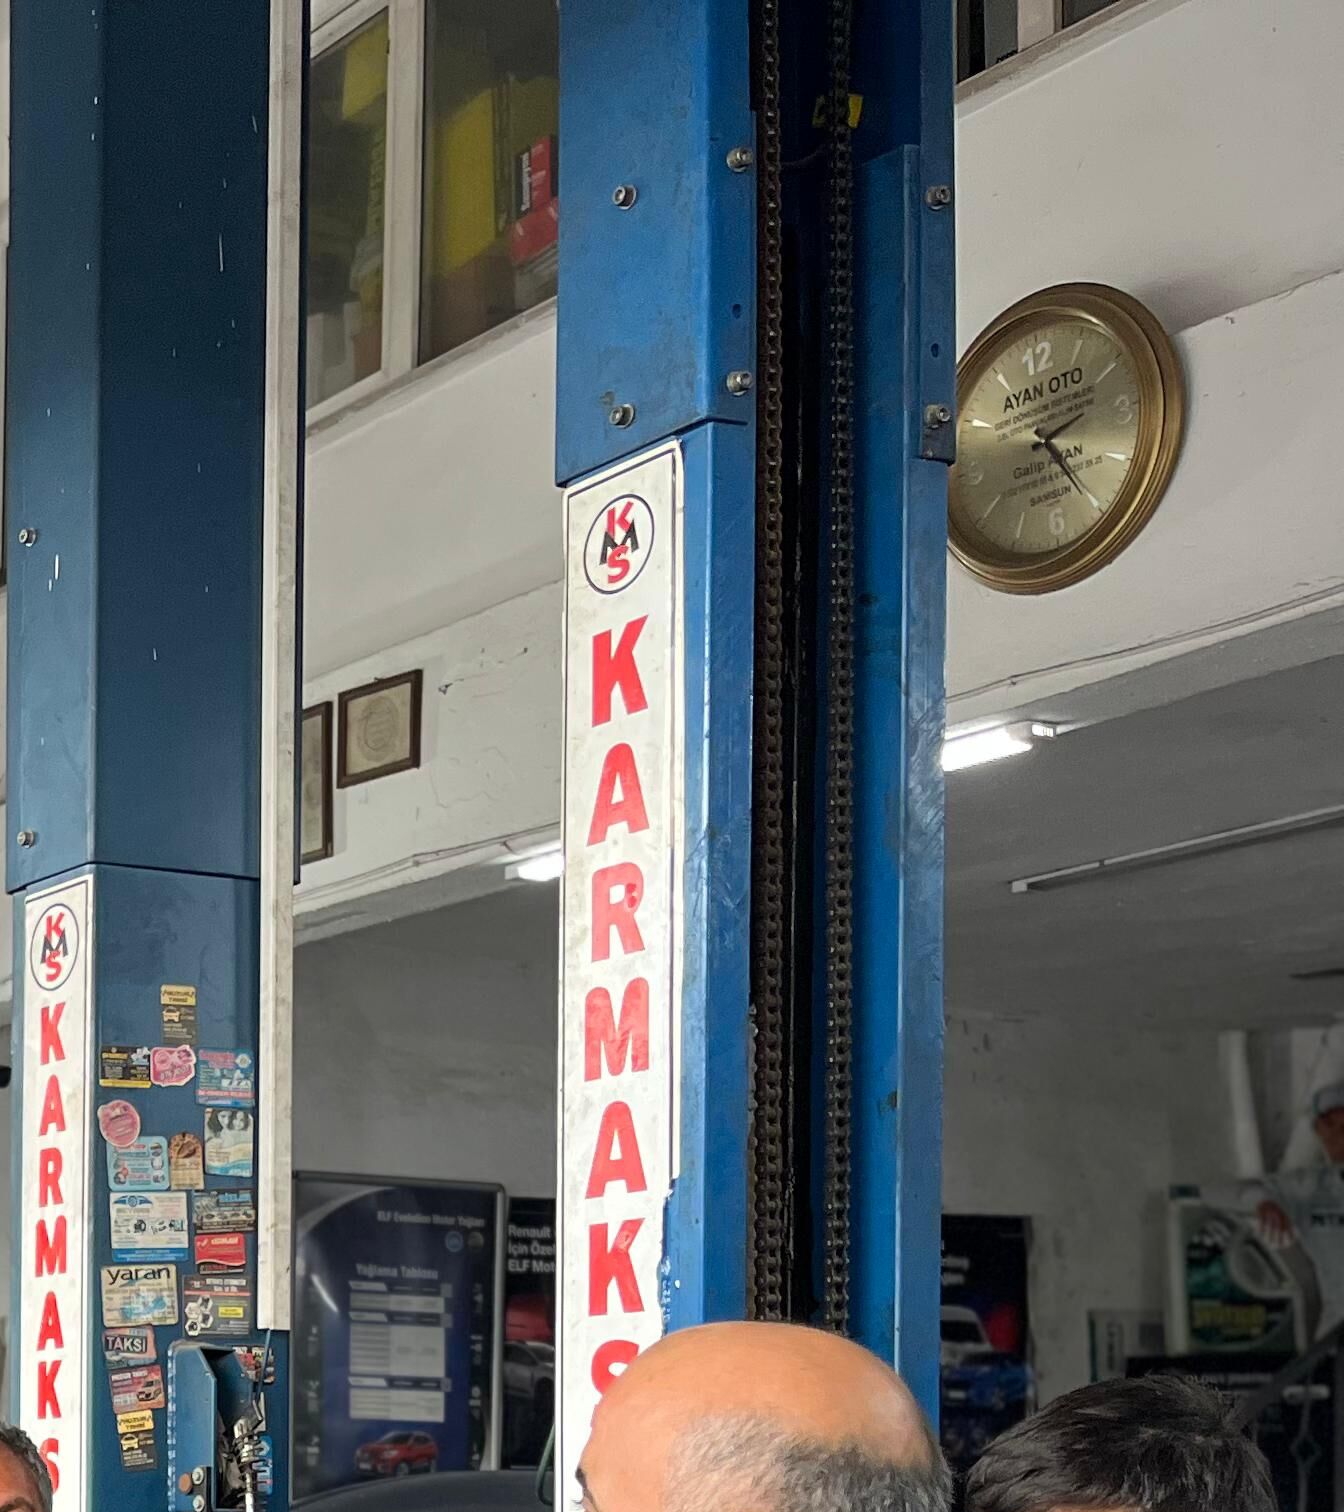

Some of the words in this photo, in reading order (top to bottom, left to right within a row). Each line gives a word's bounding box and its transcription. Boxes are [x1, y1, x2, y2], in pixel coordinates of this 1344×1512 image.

[1022, 341, 1053, 376] 12
[1003, 379, 1044, 414] AYAN
[1049, 367, 1083, 394] OTO
[1013, 460, 1045, 479] Galip
[1030, 485, 1072, 507] SAMSUN
[1048, 507, 1065, 536] 6
[508, 1224, 551, 1238] Renault
[34, 1002, 67, 1496] KARMAKS
[107, 1267, 170, 1285] yaran
[508, 1259, 530, 1272] ELF
[532, 1260, 556, 1273] Mot
